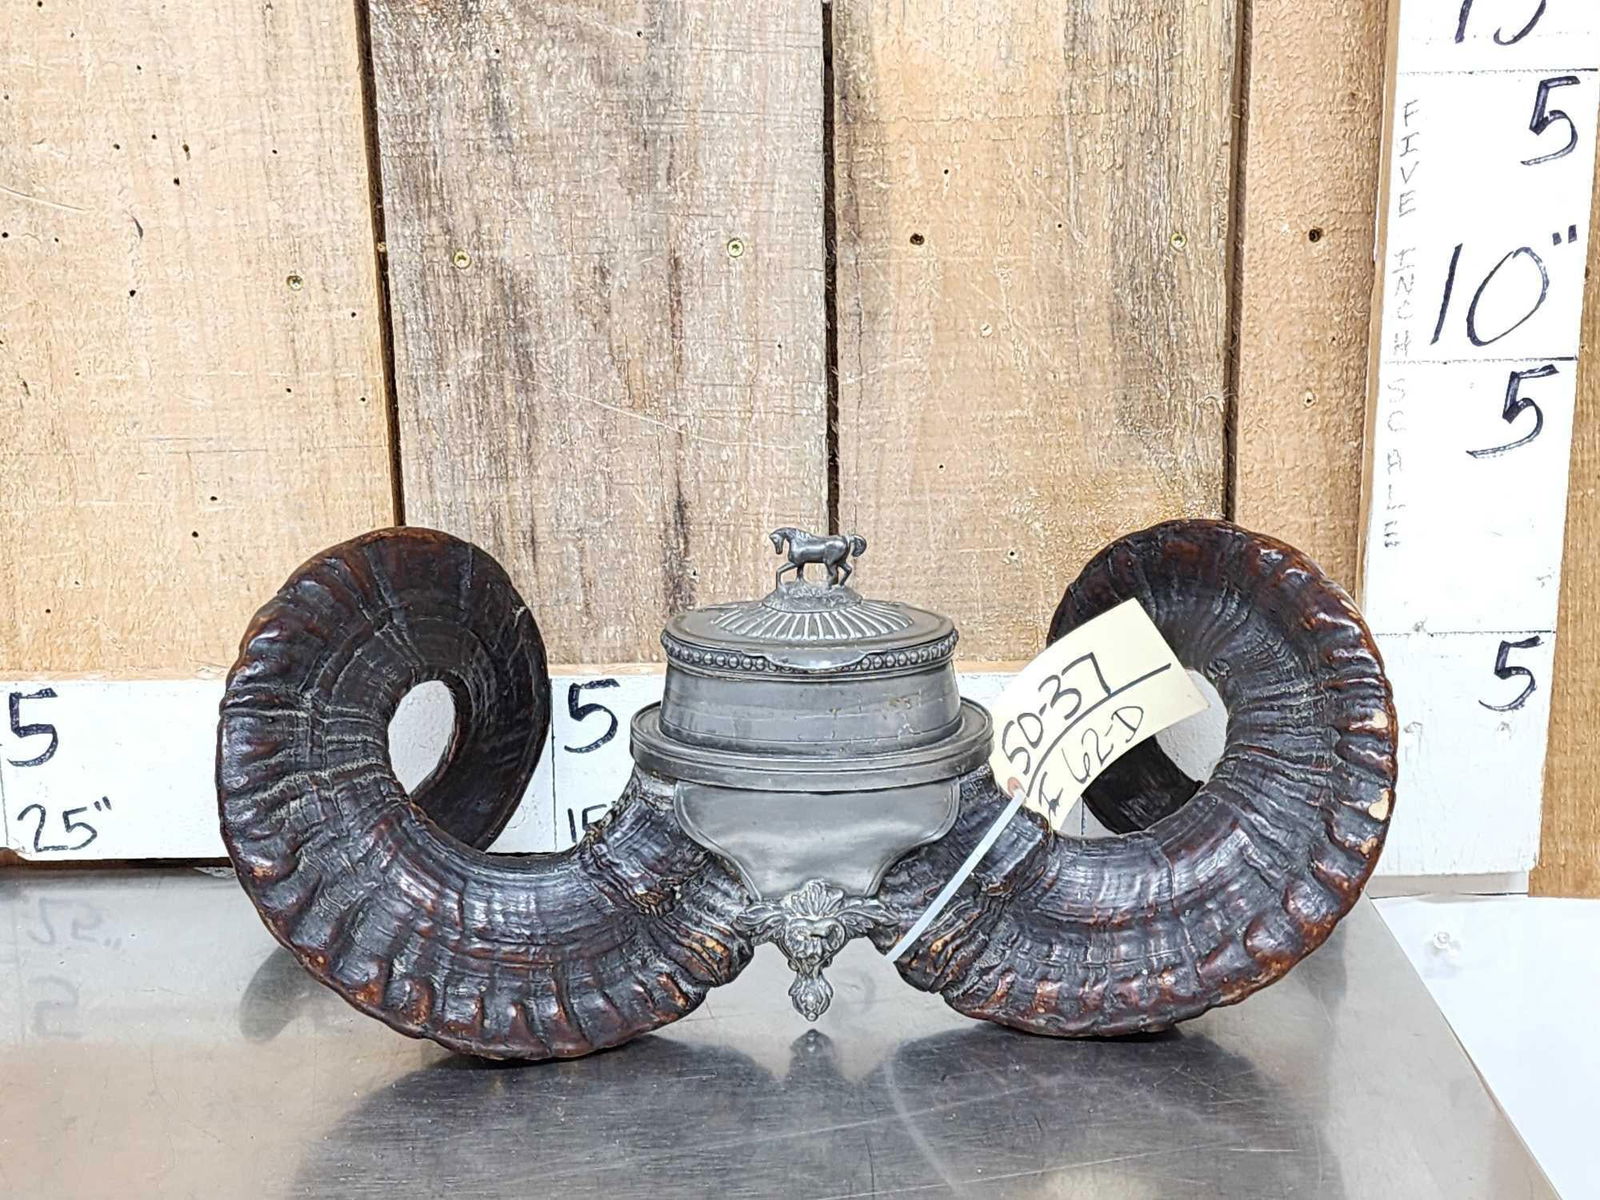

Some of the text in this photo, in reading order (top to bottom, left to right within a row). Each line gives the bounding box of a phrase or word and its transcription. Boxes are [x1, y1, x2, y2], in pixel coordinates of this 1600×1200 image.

[1398, 99, 1420, 218] FIVE
[1520, 75, 1581, 165] 5
[1430, 223, 1578, 347] 10"
[1466, 363, 1560, 459] 5
[563, 678, 621, 754] 5
[1002, 651, 1112, 776] 50-37
[1477, 634, 1545, 712] 5
[7, 687, 59, 768] 5
[17, 795, 113, 853] 25"
